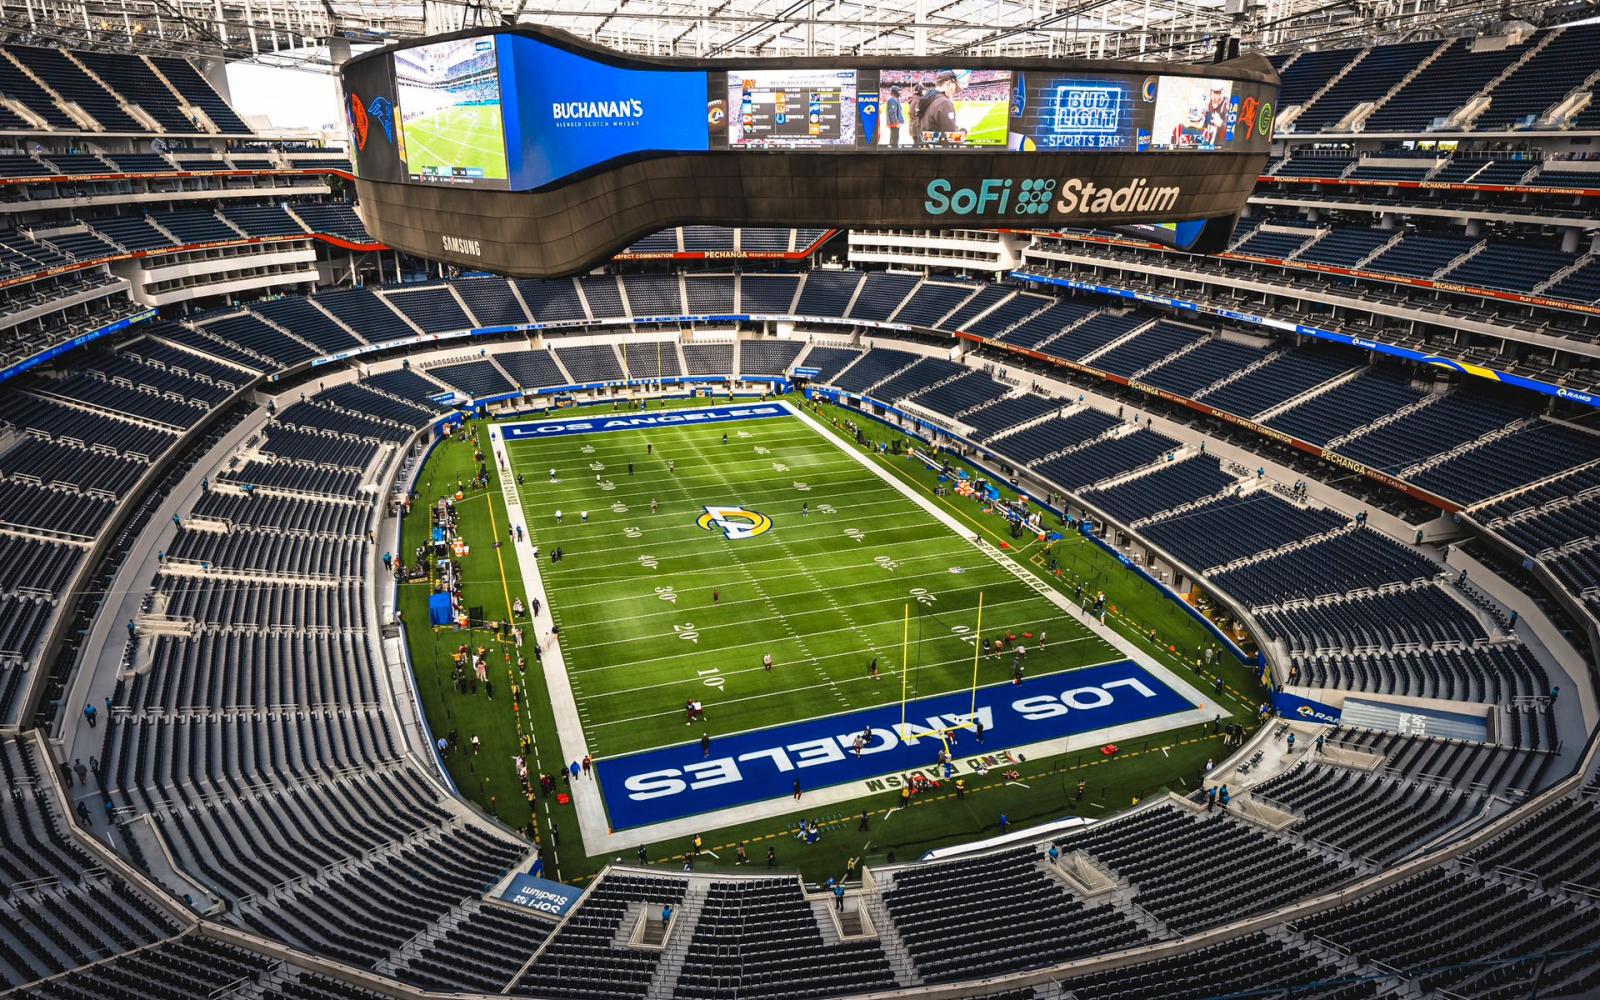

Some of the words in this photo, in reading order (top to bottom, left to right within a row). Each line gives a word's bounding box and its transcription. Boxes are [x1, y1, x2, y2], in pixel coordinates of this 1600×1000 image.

[552, 98, 644, 119] BUCHANAN'S
[1069, 91, 1109, 108] BUD
[1060, 109, 1116, 128] LIGHT
[1048, 136, 1096, 146] SPORTS
[1098, 136, 1120, 147] BAR
[924, 178, 1013, 215] SoFi
[1057, 178, 1180, 214] Stadium
[442, 236, 480, 256] SAMSUNG
[1433, 282, 1465, 292] PECHANGA
[1546, 300, 1567, 308] PERFECT
[1128, 380, 1159, 396] PECHANGA
[1566, 391, 1592, 403] RAMS
[512, 422, 594, 435] LOS
[604, 407, 778, 428] ANGELES
[1212, 410, 1224, 418] PLAY
[1224, 414, 1236, 422] YOUR
[1237, 418, 1257, 431] PERFECT
[1257, 426, 1292, 444] COMBINATION
[1321, 450, 1366, 475] PECHANGA
[1387, 479, 1408, 491] CASINO
[638, 555, 658, 567] 40
[1007, 562, 1053, 594] CHANGE
[654, 586, 678, 600] 30
[910, 588, 938, 602] 20
[674, 622, 699, 640] 20
[951, 626, 981, 642] 10
[697, 667, 725, 687] 10
[1010, 677, 1157, 721] LOS
[624, 705, 993, 801] ANGELES
[522, 886, 568, 906] Stadium
